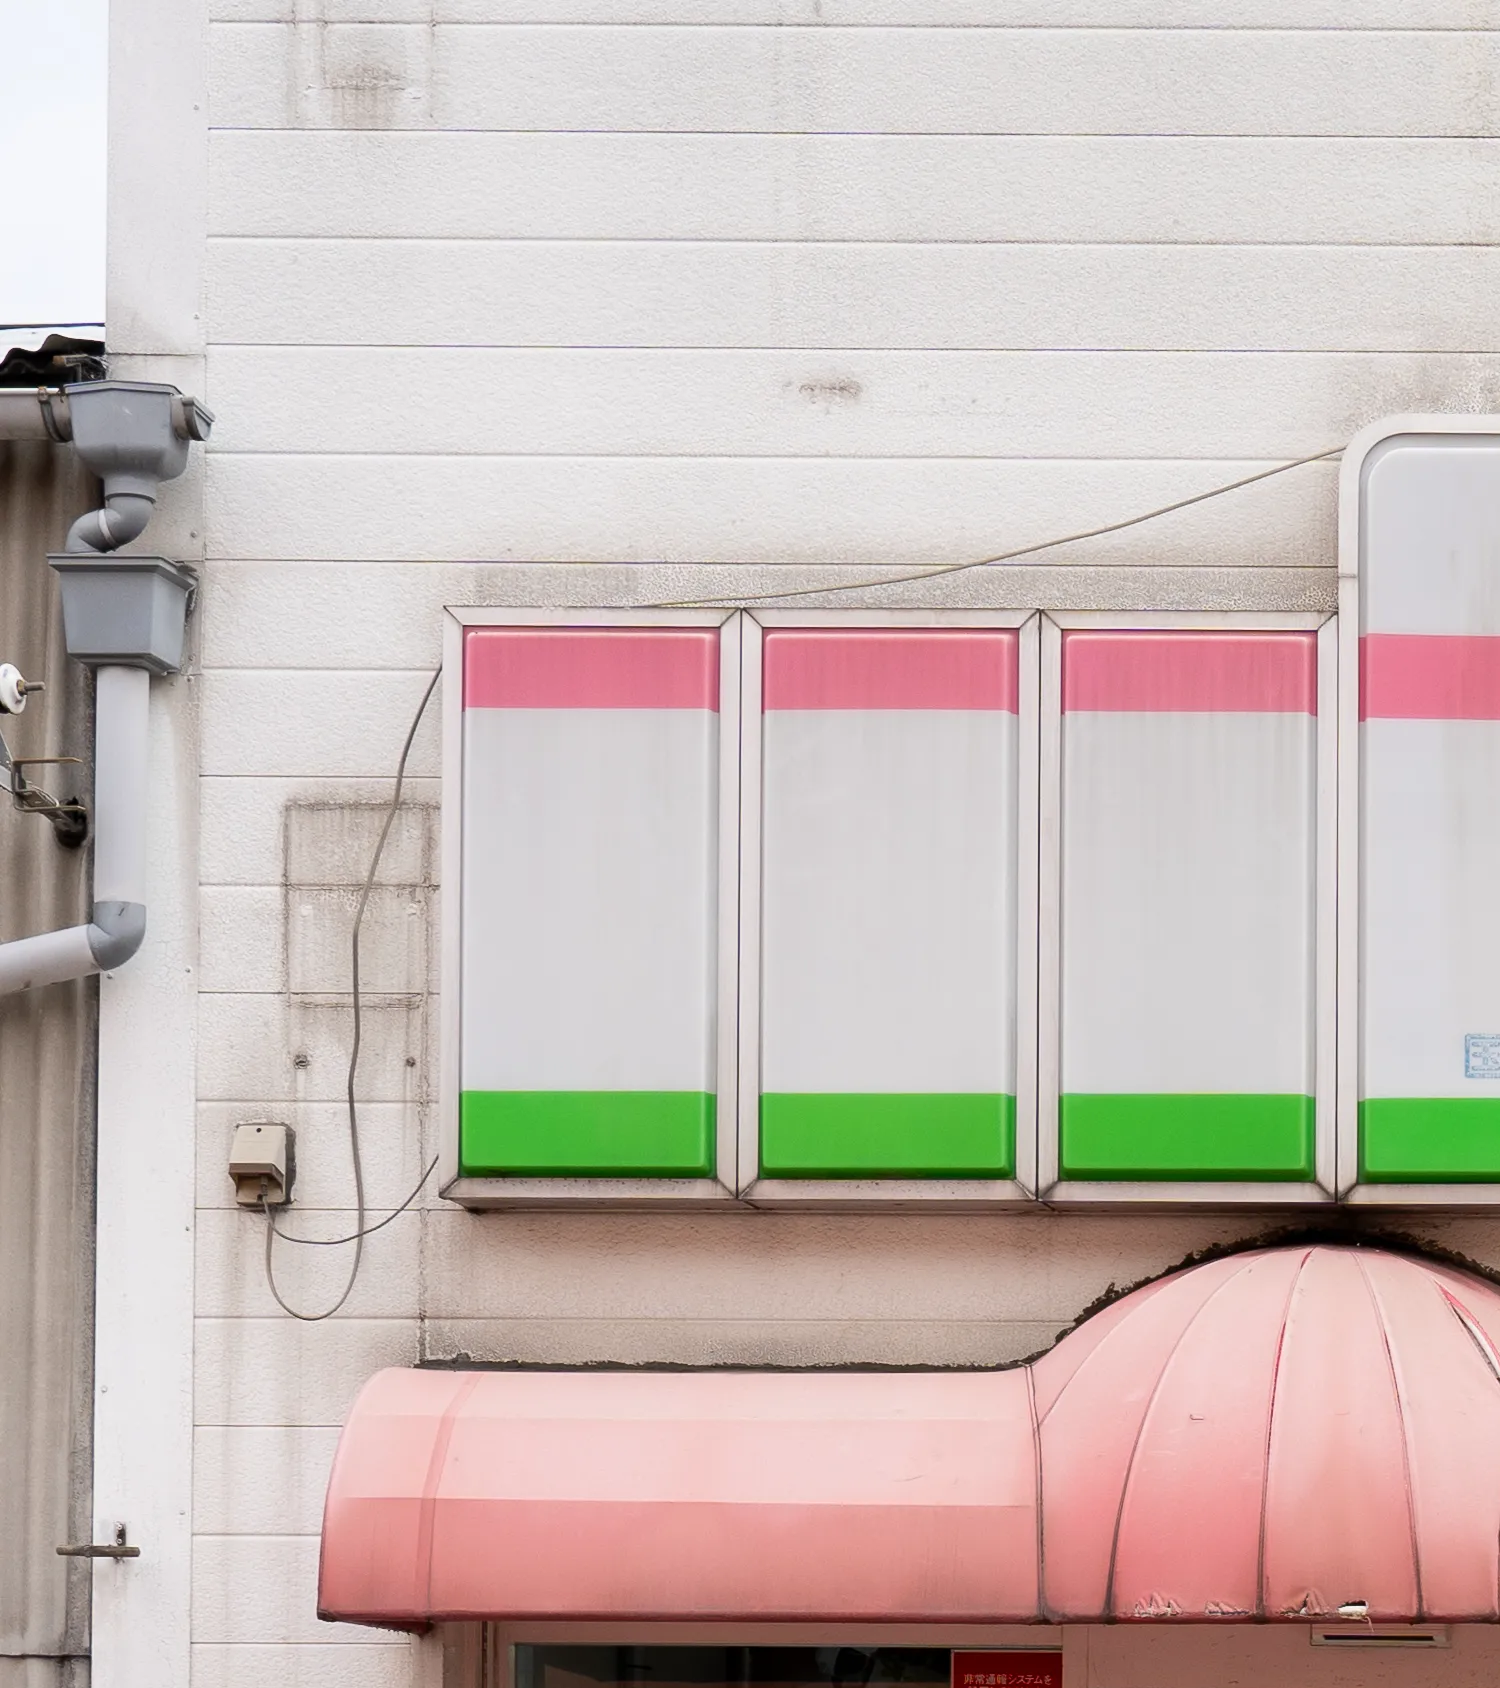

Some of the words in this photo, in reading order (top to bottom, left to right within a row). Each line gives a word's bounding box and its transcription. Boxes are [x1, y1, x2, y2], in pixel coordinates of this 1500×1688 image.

[963, 1673, 1053, 1686] 非常通報システムを
